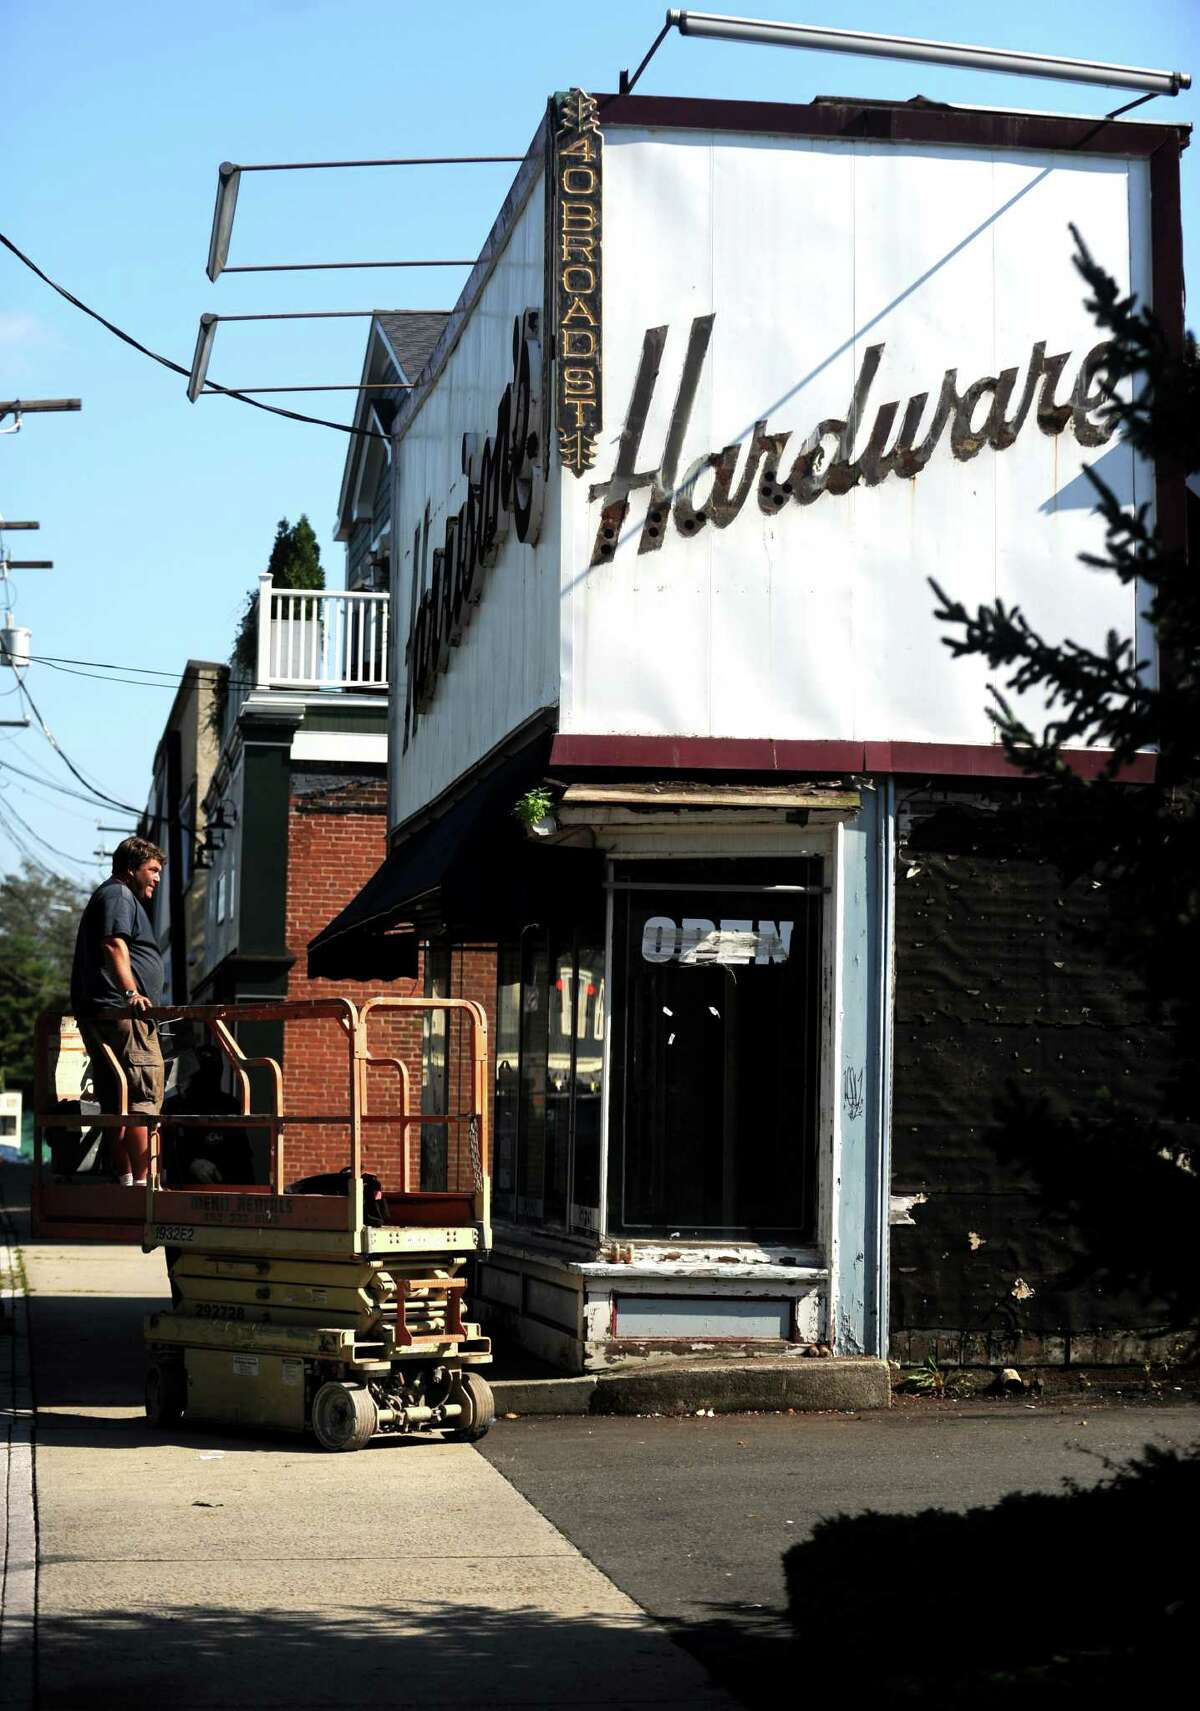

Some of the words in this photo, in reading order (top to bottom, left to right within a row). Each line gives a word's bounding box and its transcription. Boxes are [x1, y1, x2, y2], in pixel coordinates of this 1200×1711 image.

[560, 135, 597, 194] 40
[561, 200, 599, 357] BROAD
[586, 312, 1122, 567] Hardware
[641, 916, 795, 965] OPEN
